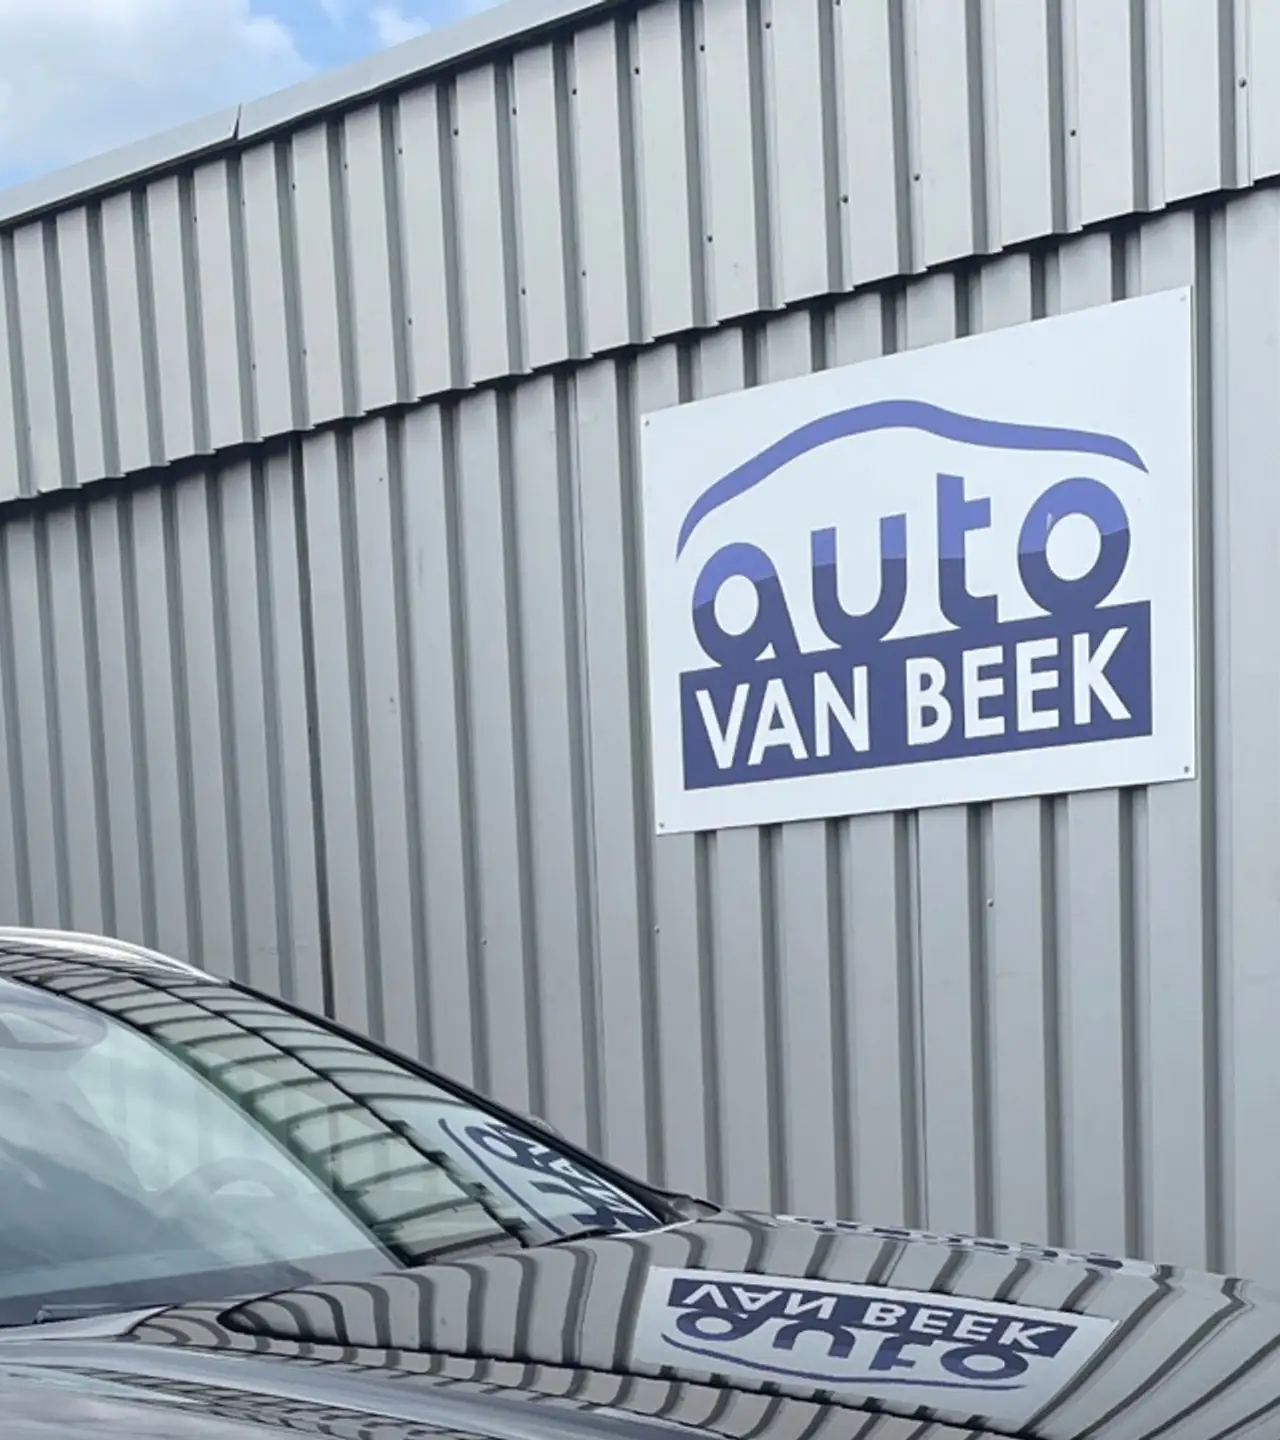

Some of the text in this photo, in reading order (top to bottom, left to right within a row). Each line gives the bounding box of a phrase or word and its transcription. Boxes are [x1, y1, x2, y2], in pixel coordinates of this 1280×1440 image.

[692, 473, 1131, 662] auto
[696, 627, 1132, 770] VAN BEEK
